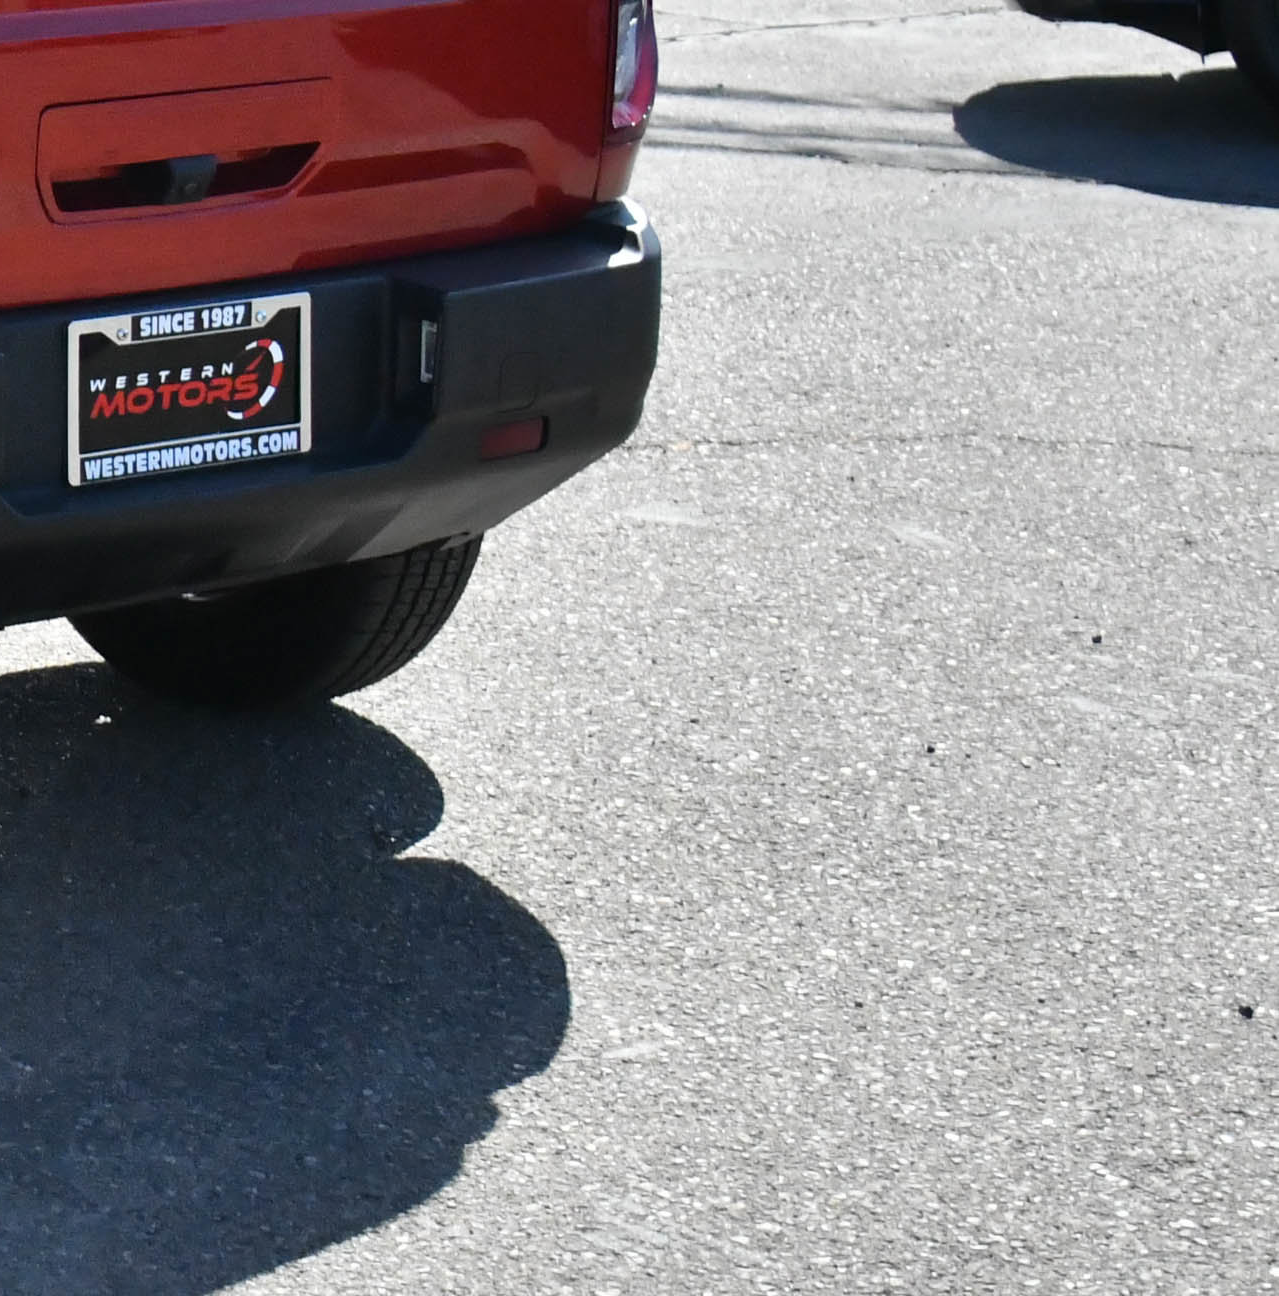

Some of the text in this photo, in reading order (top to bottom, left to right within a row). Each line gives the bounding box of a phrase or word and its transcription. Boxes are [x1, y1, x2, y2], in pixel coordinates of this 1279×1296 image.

[140, 304, 245, 337] SINCE 1987
[89, 361, 234, 392] WESTERN
[89, 373, 259, 419] MOTORS
[84, 430, 298, 481] WESTERNMOTORS.COM
